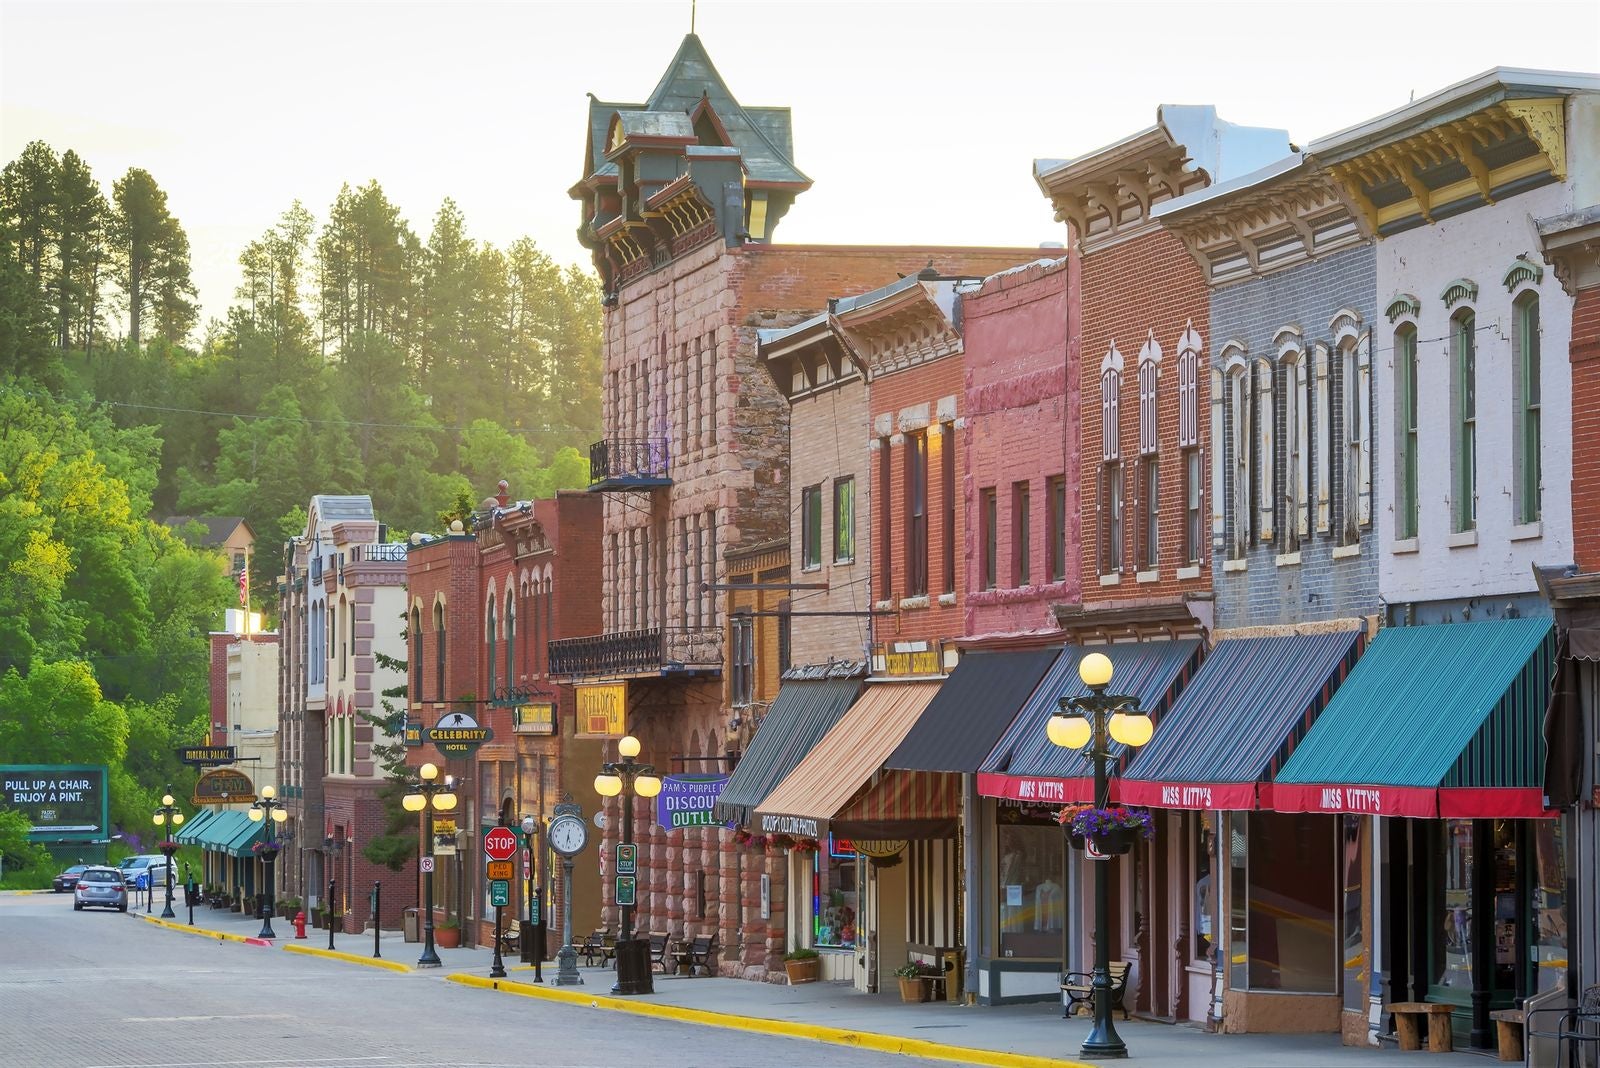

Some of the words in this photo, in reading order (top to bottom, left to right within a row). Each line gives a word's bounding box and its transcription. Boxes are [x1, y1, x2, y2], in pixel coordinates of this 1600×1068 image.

[429, 729, 487, 740] CELEBRITY
[186, 750, 209, 760] MINERAL
[5, 781, 30, 790] PULL
[32, 781, 46, 790] UP
[48, 780, 56, 790] A
[58, 780, 92, 790] CHAIR.
[211, 777, 247, 793] GEM
[663, 782, 687, 793] PAM'S
[689, 783, 716, 793] PURPLE
[1019, 780, 1036, 798] MISS
[1038, 781, 1064, 800] KITTY'S
[14, 792, 47, 803] ENJOY
[49, 792, 57, 802] A
[59, 792, 84, 802] PINT.
[1162, 786, 1180, 806] MISS
[1183, 787, 1212, 807] KITTY'S
[1320, 788, 1342, 809] MISS
[672, 811, 723, 827] OUTLE
[487, 837, 515, 850] STOP
